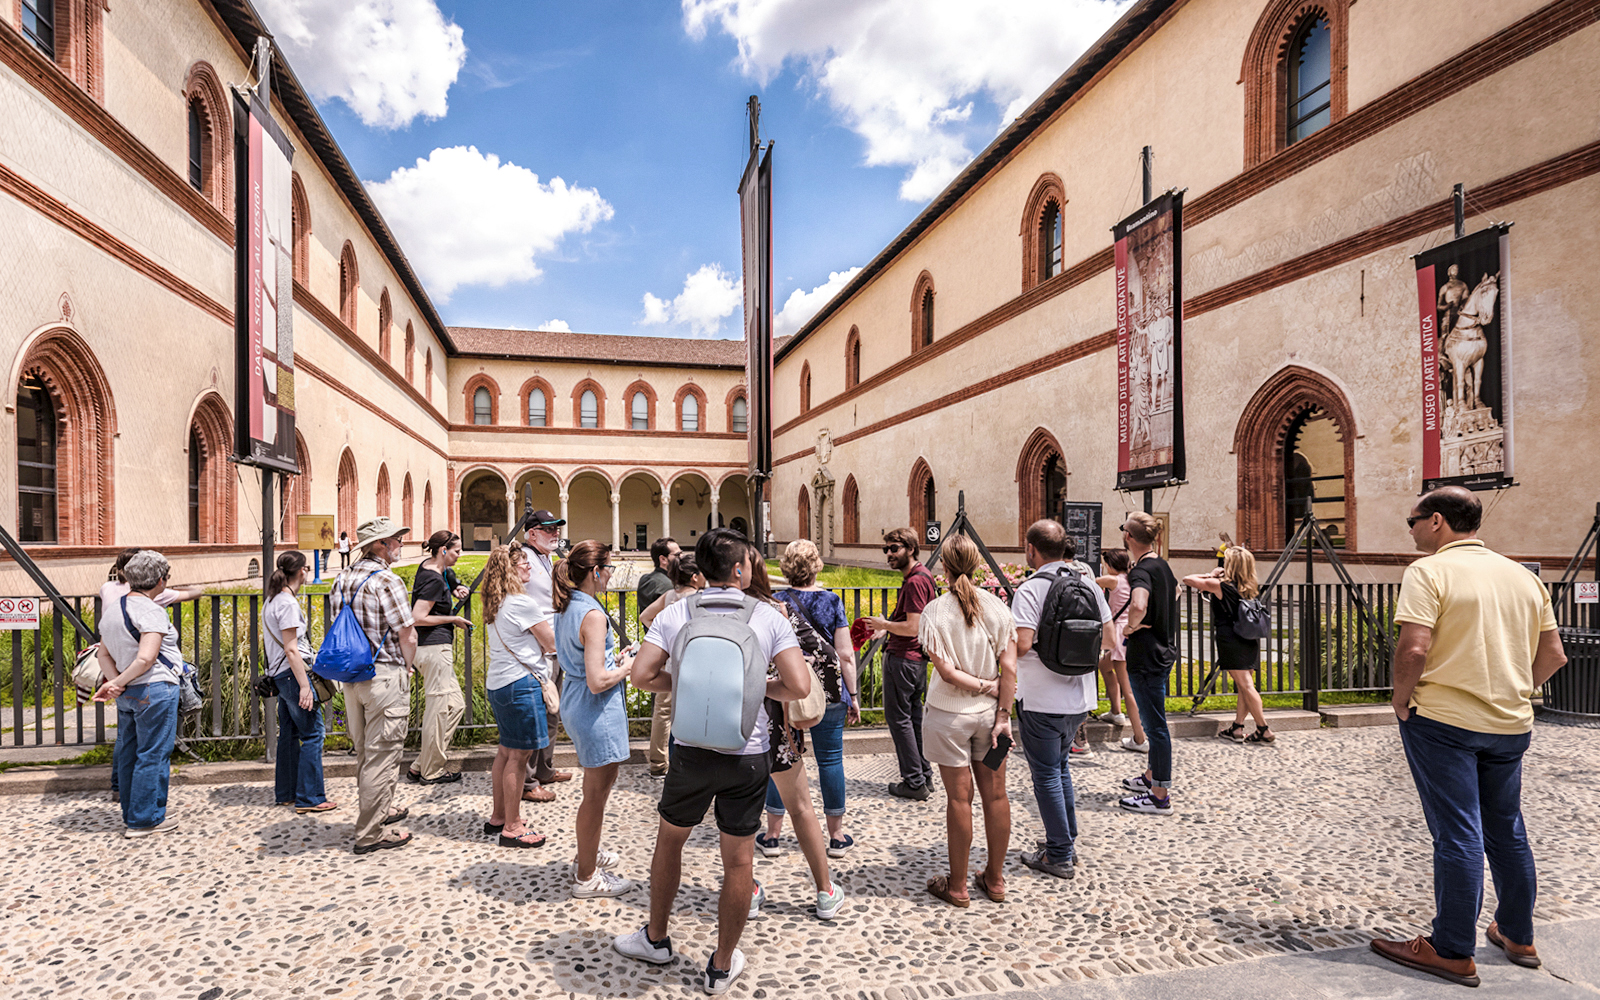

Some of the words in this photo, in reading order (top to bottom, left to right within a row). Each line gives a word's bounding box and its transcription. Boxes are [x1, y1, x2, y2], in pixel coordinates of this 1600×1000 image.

[254, 246, 261, 264] AL
[1117, 266, 1127, 336] DECORATIVE
[1118, 338, 1127, 363] ARTI
[1422, 314, 1434, 352] ANTICA
[1119, 366, 1127, 400] DELLE
[1423, 355, 1435, 391] D'ARTE
[1120, 403, 1128, 443] MUSEO
[1425, 394, 1436, 431] MUSEO
